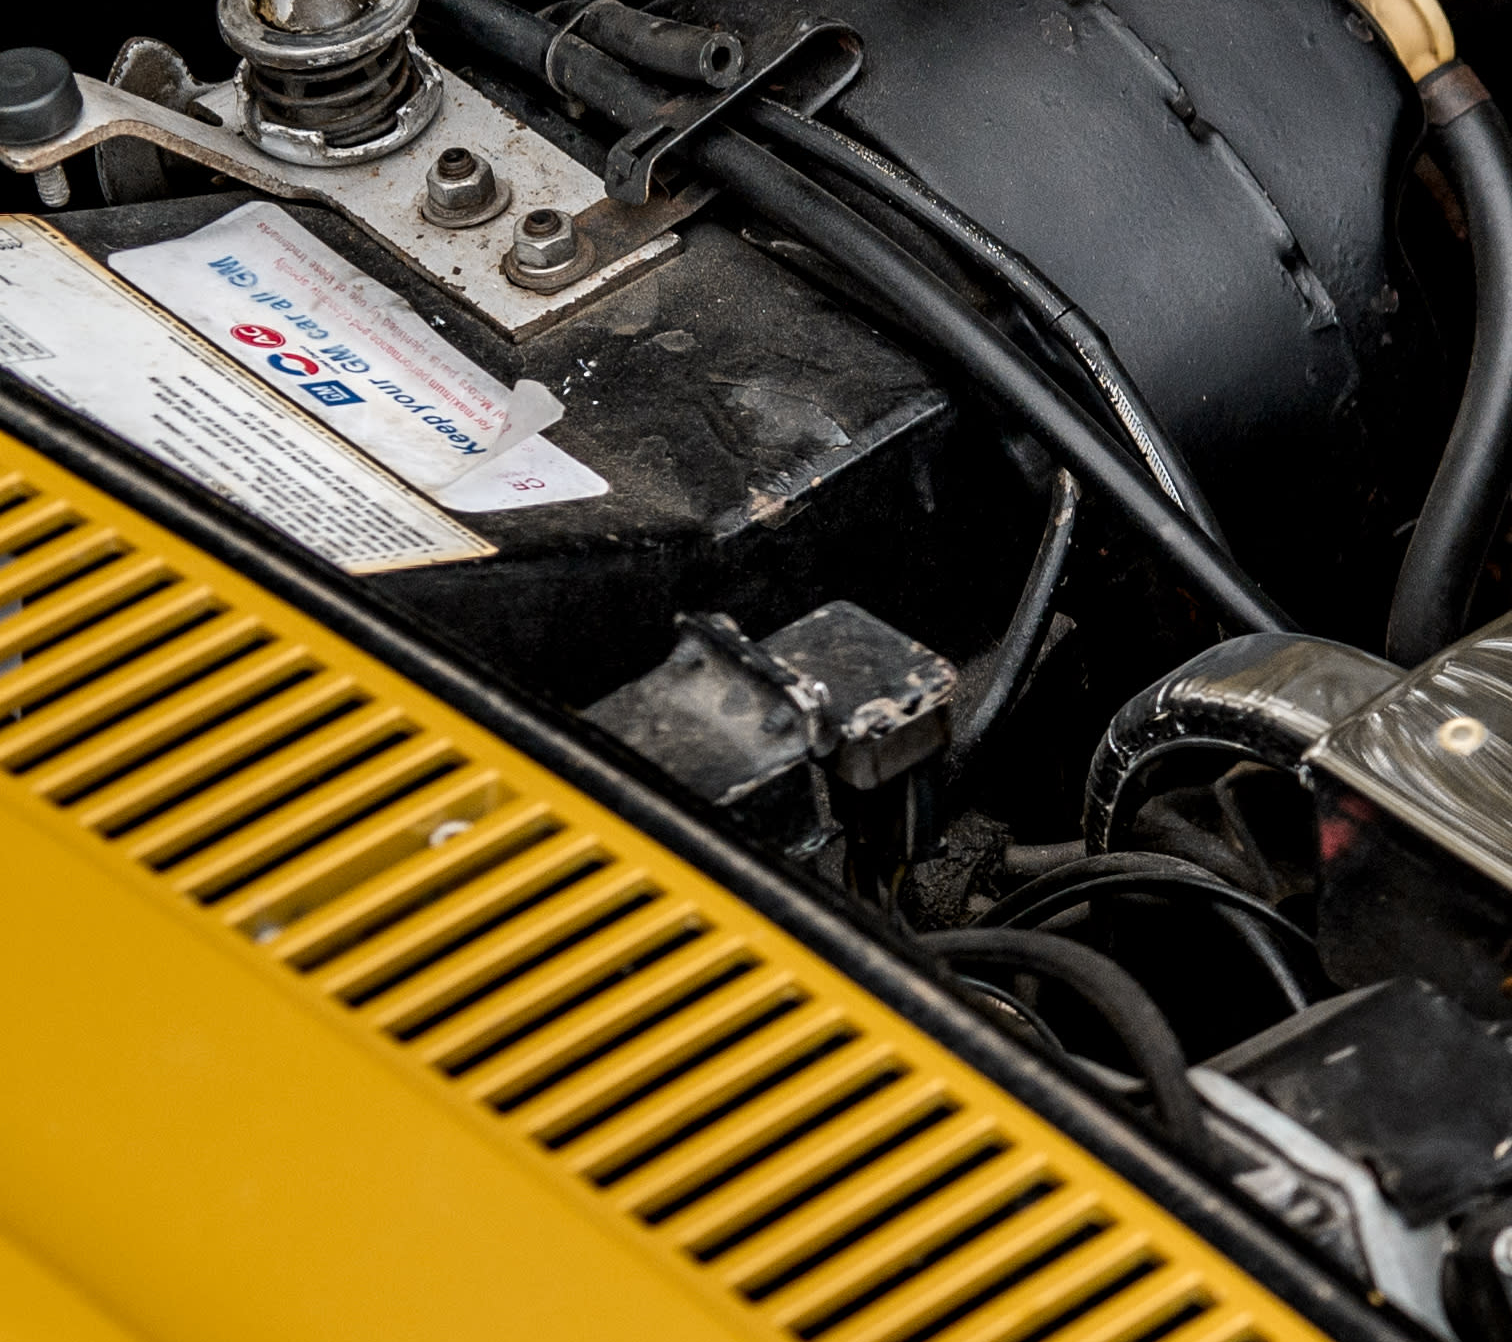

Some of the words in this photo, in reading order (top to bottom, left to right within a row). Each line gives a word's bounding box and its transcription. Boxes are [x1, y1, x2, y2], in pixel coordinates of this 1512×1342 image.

[256, 221, 309, 264] trademarks
[207, 255, 259, 288] GM
[308, 260, 336, 285] these
[249, 291, 293, 311] all
[283, 314, 329, 340] car
[318, 344, 371, 374] GM
[369, 332, 432, 382] performance
[368, 378, 437, 414] your
[427, 378, 477, 419] maximum
[421, 415, 488, 455] Keep
[473, 416, 495, 432] For
